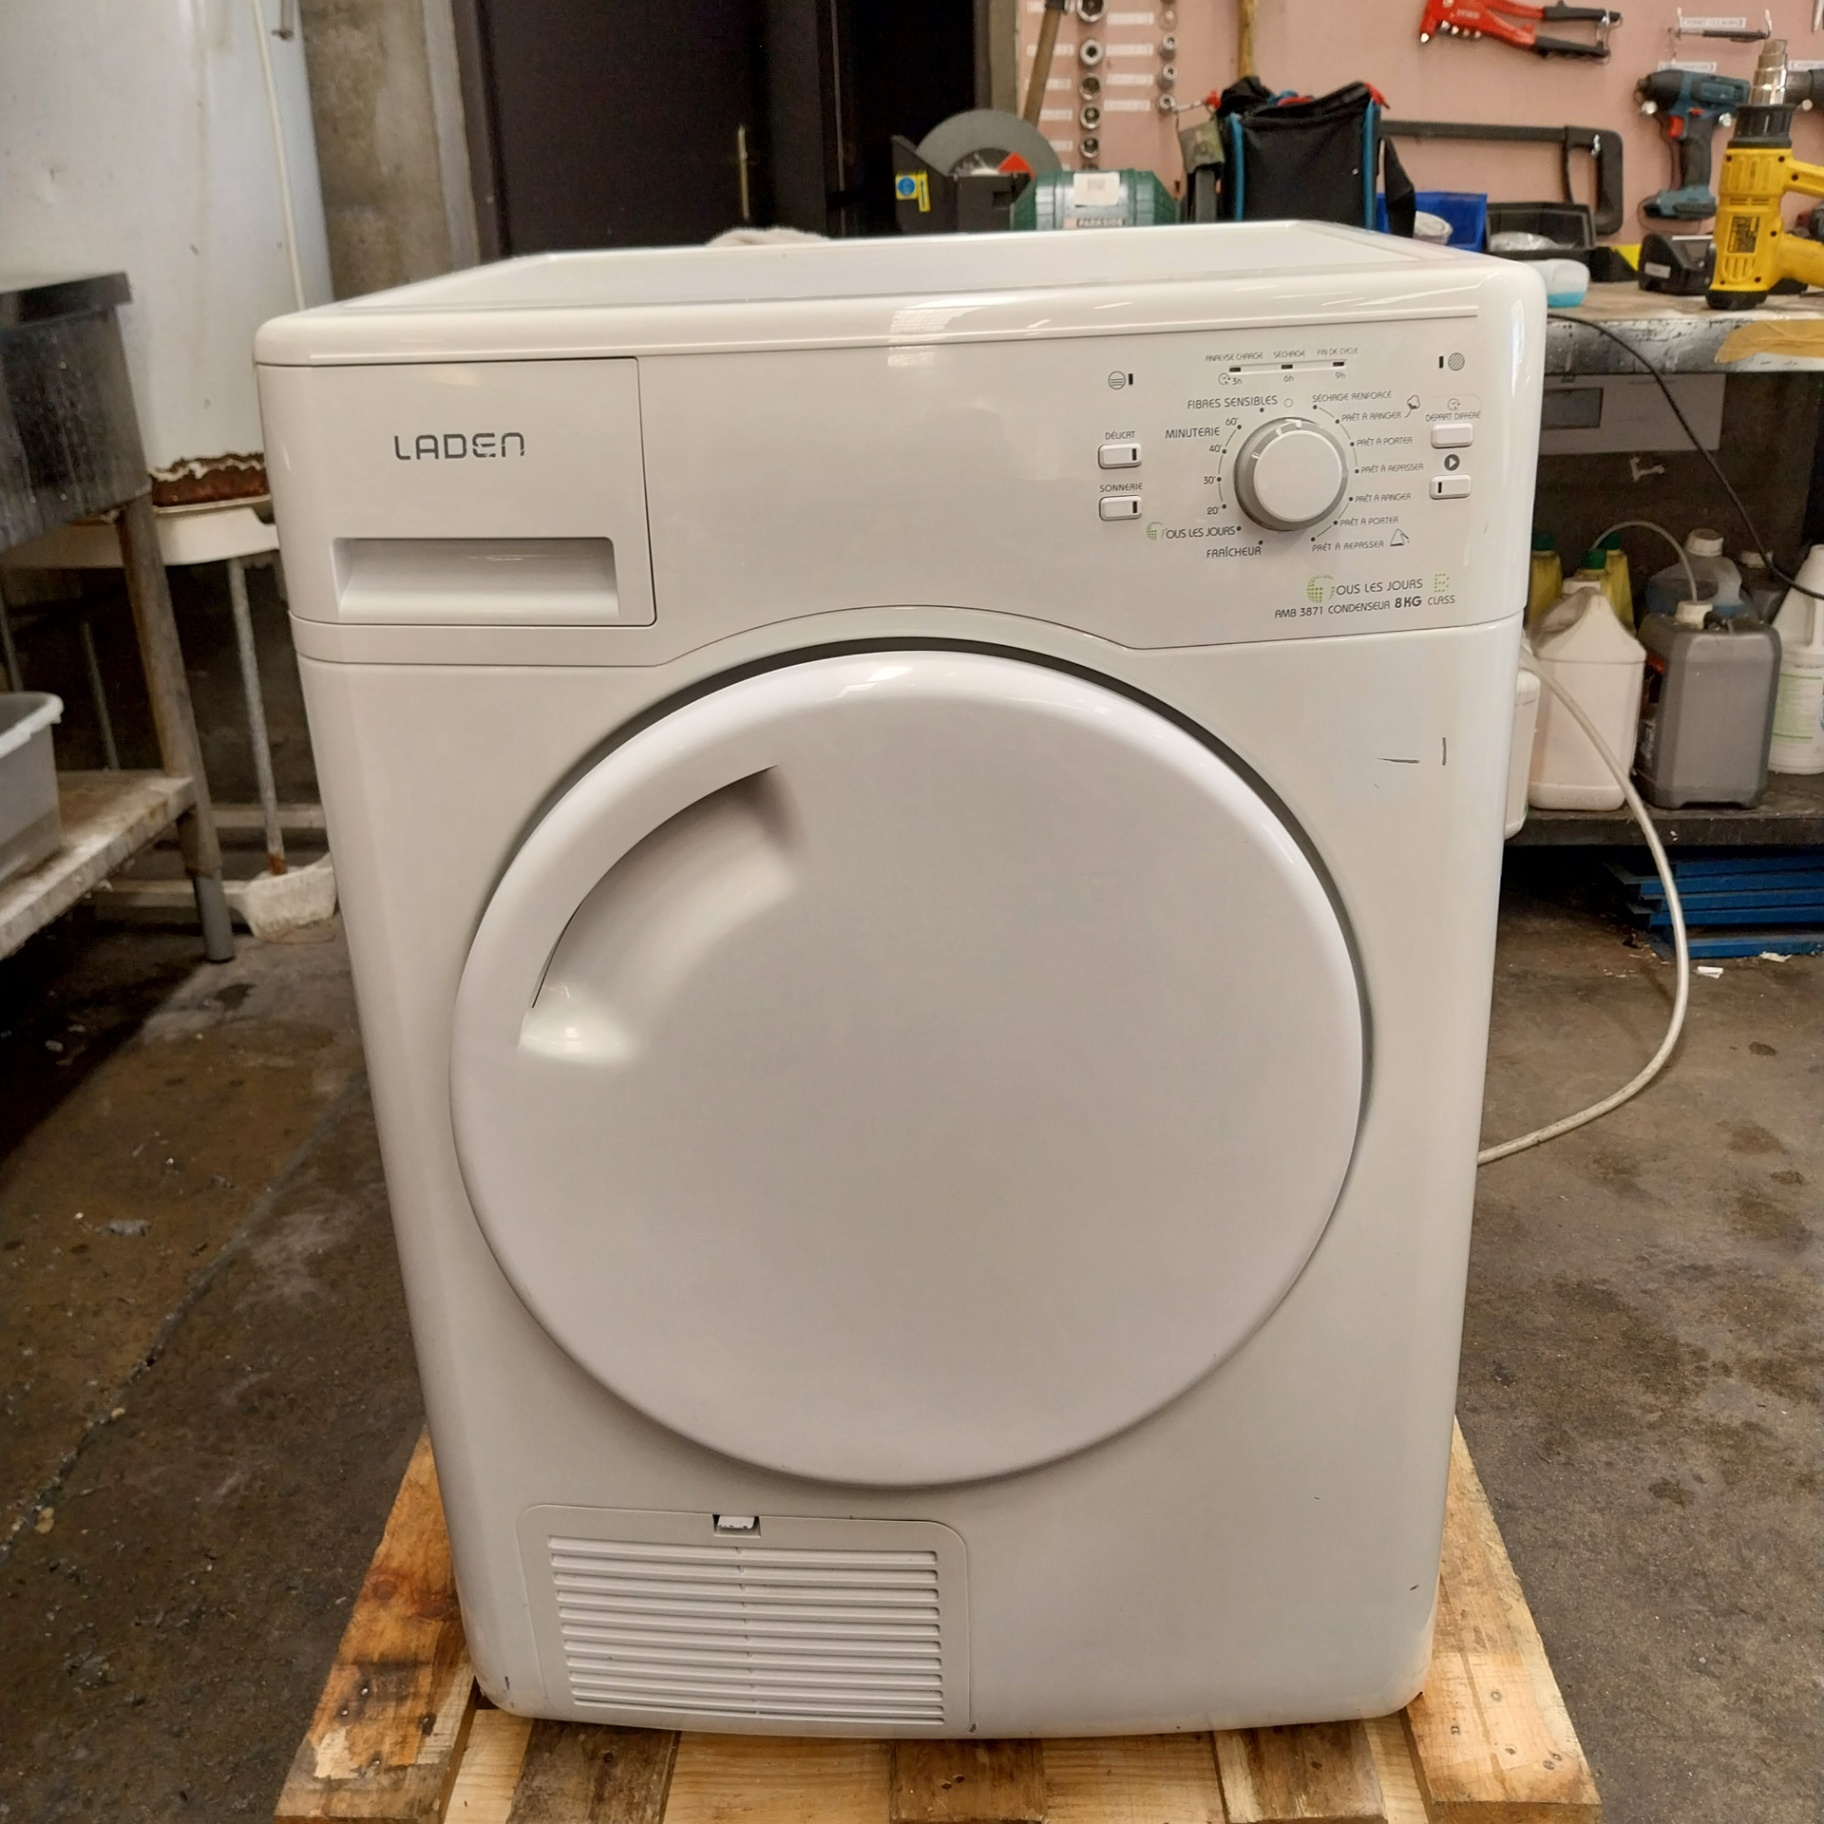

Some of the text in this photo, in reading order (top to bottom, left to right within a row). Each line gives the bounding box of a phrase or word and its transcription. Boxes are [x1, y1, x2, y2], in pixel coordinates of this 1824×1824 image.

[1236, 351, 1264, 360] CHARGE
[1316, 348, 1328, 356] FIN
[1340, 346, 1359, 355] CYCLE
[1283, 374, 1294, 383] 6h
[1335, 371, 1346, 380] 9h
[1232, 377, 1243, 385] 3h
[1187, 395, 1278, 410] FIBRES SENSIBLES
[1369, 411, 1402, 420] RANGER
[1105, 430, 1135, 440] DÉLICAT
[1165, 426, 1220, 439] MINUTERIE
[394, 432, 525, 460] LADEN
[1383, 436, 1413, 446] PORTER
[1388, 463, 1424, 473] REPASSER
[1099, 482, 1143, 492] SONNERIE
[1381, 492, 1412, 502] RANGER
[1368, 516, 1399, 525] PORTER
[1188, 527, 1204, 538] LES
[1206, 525, 1236, 537] JOURS
[1343, 540, 1384, 550] REPASSER
[1206, 545, 1262, 558] FRAÎCHEUR
[1364, 581, 1383, 594] LES
[1386, 578, 1424, 592] JOURS
[1274, 608, 1297, 619] AMB
[1299, 607, 1323, 618] 3871
[1327, 600, 1391, 615] CONDENSEUR
[1427, 594, 1456, 606] CLASS
